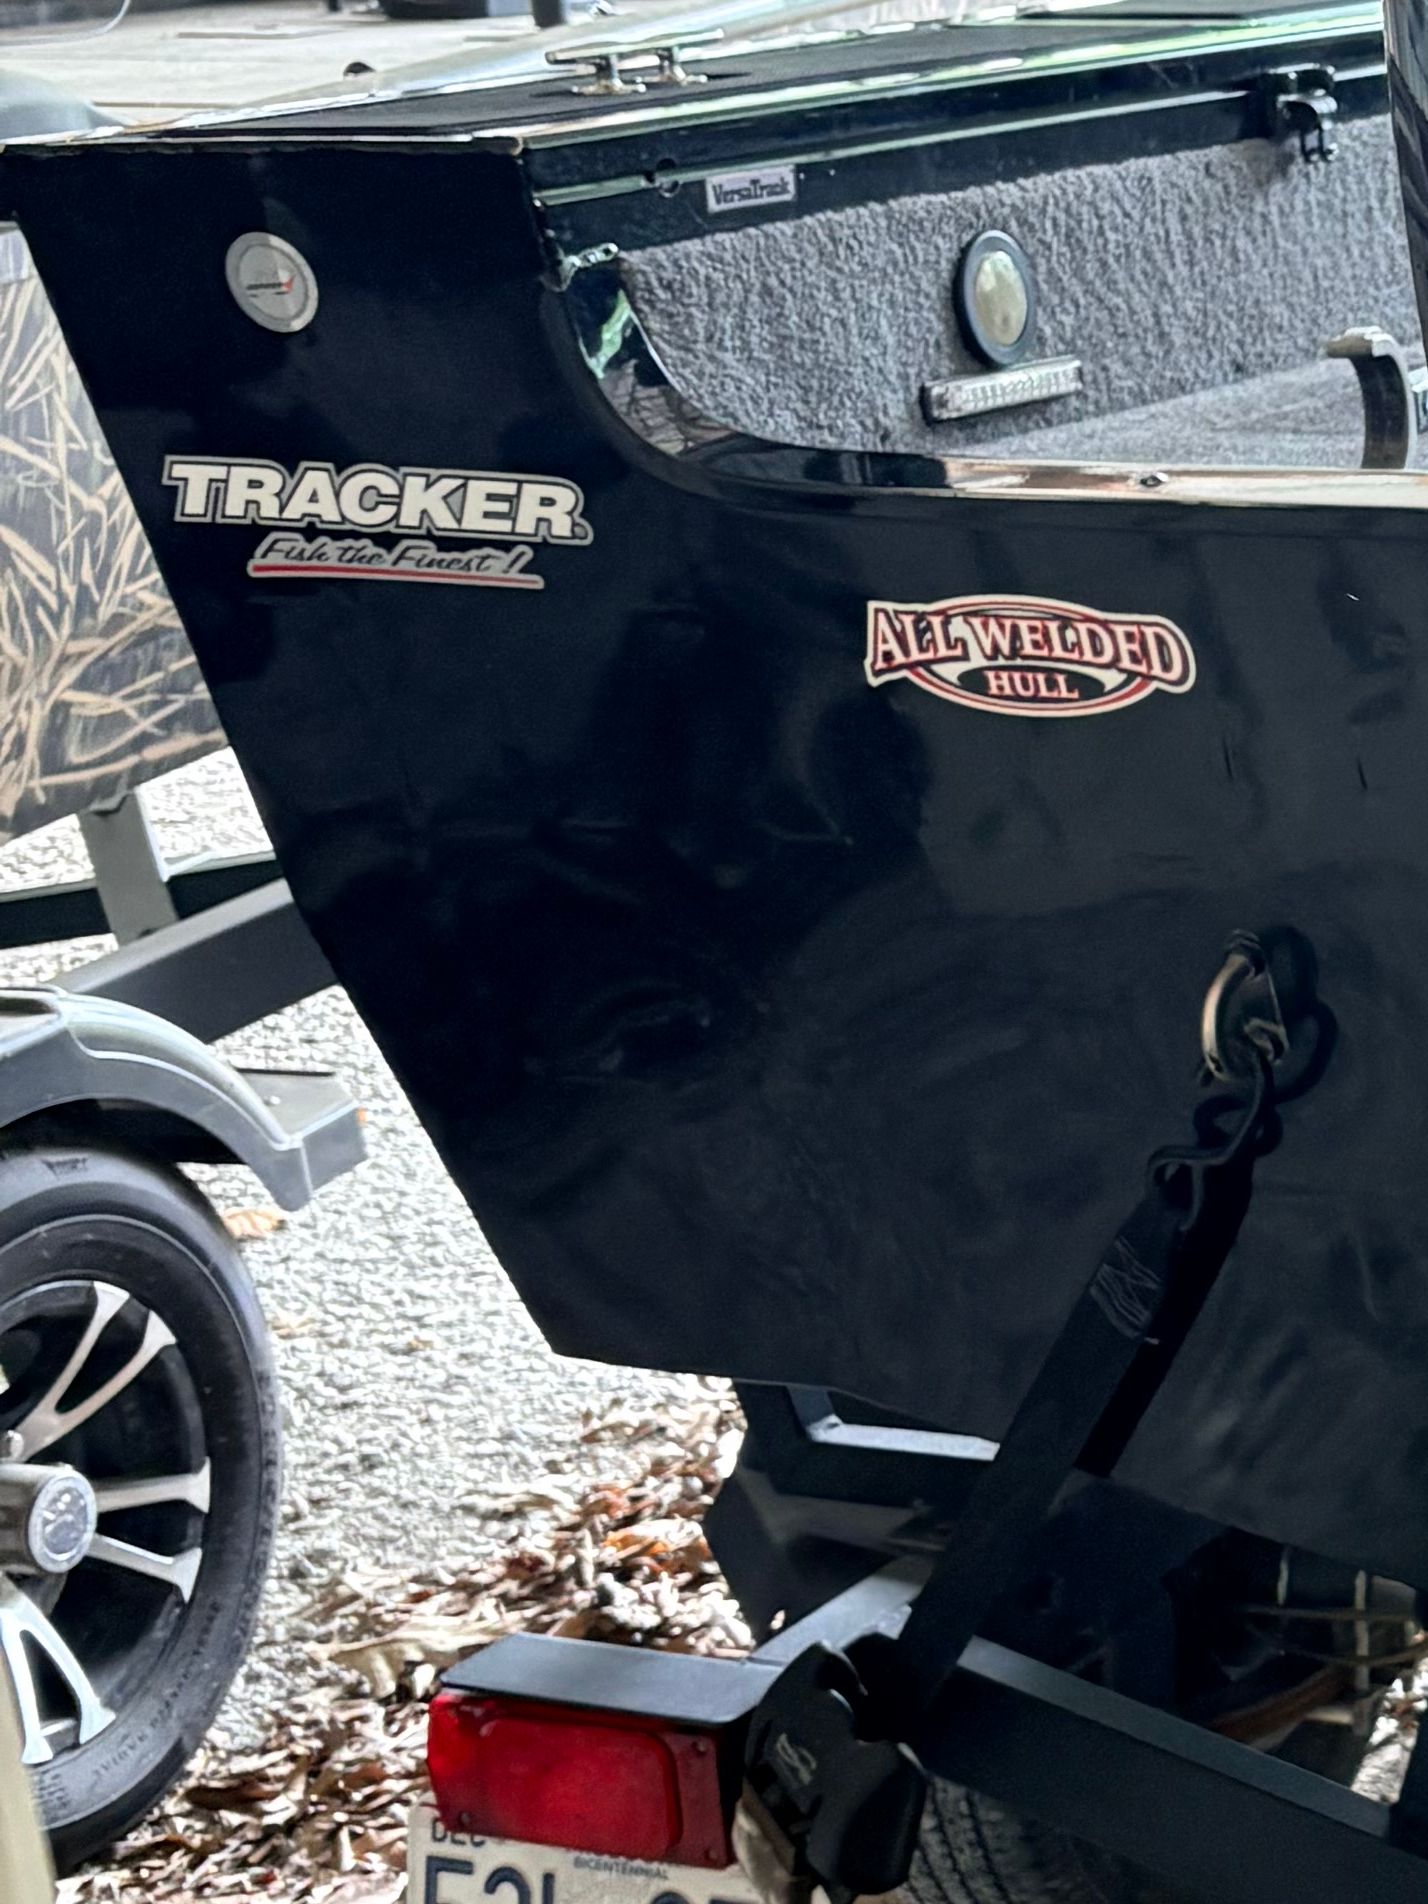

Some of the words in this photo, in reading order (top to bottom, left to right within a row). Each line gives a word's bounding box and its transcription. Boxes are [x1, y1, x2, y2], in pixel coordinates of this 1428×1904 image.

[167, 460, 581, 541] TRACKER
[261, 537, 330, 563] Fish
[337, 543, 384, 565] the
[871, 609, 964, 671] ALL
[966, 616, 1184, 682] WELDED
[982, 669, 1080, 700] HULL
[573, 1855, 669, 1880] BICENTENNIAL
